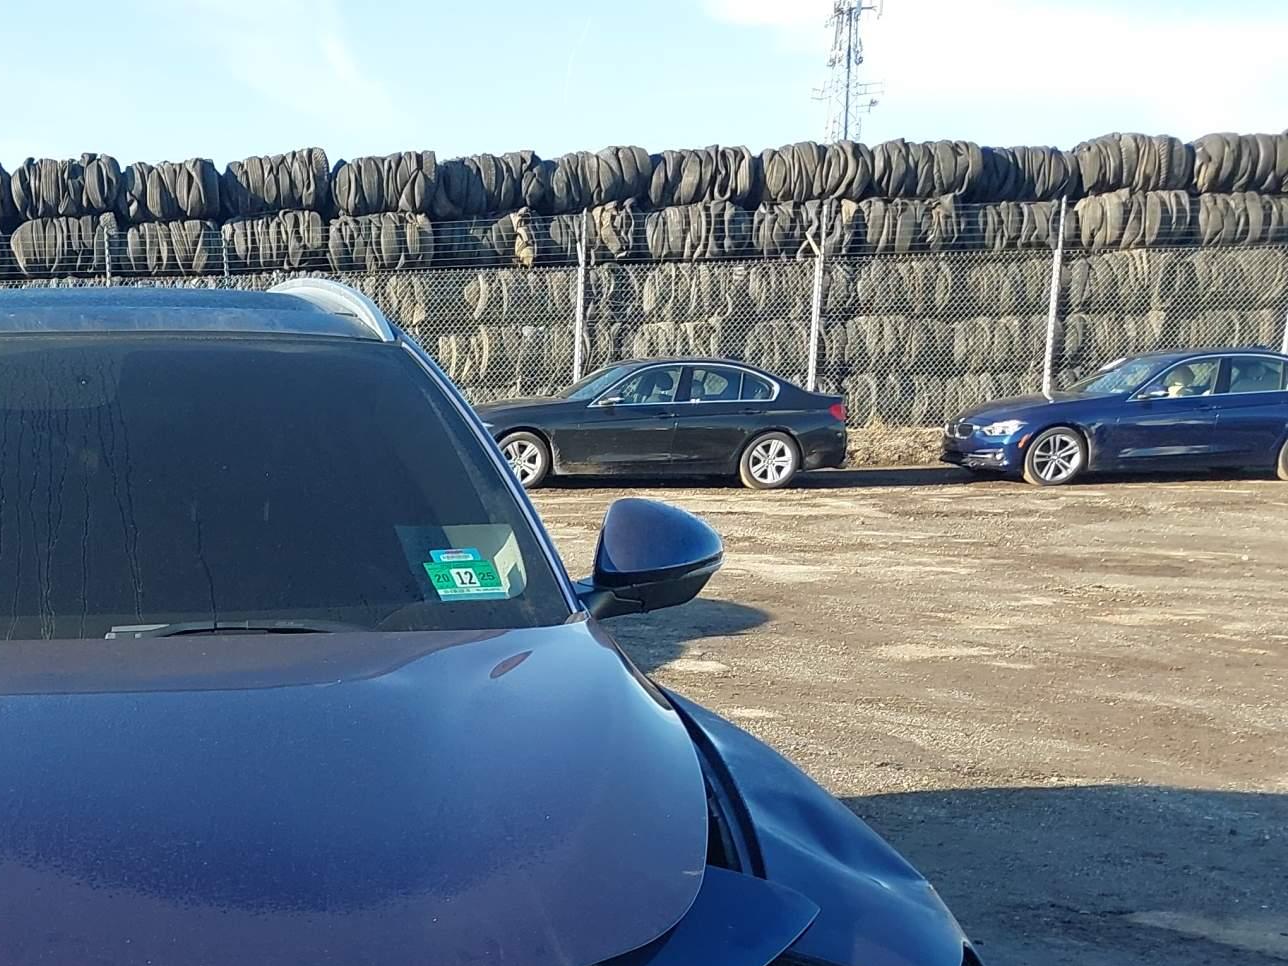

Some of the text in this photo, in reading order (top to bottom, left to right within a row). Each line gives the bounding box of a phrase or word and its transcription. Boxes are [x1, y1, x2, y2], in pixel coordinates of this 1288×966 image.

[435, 570, 496, 585] 20 12 25
